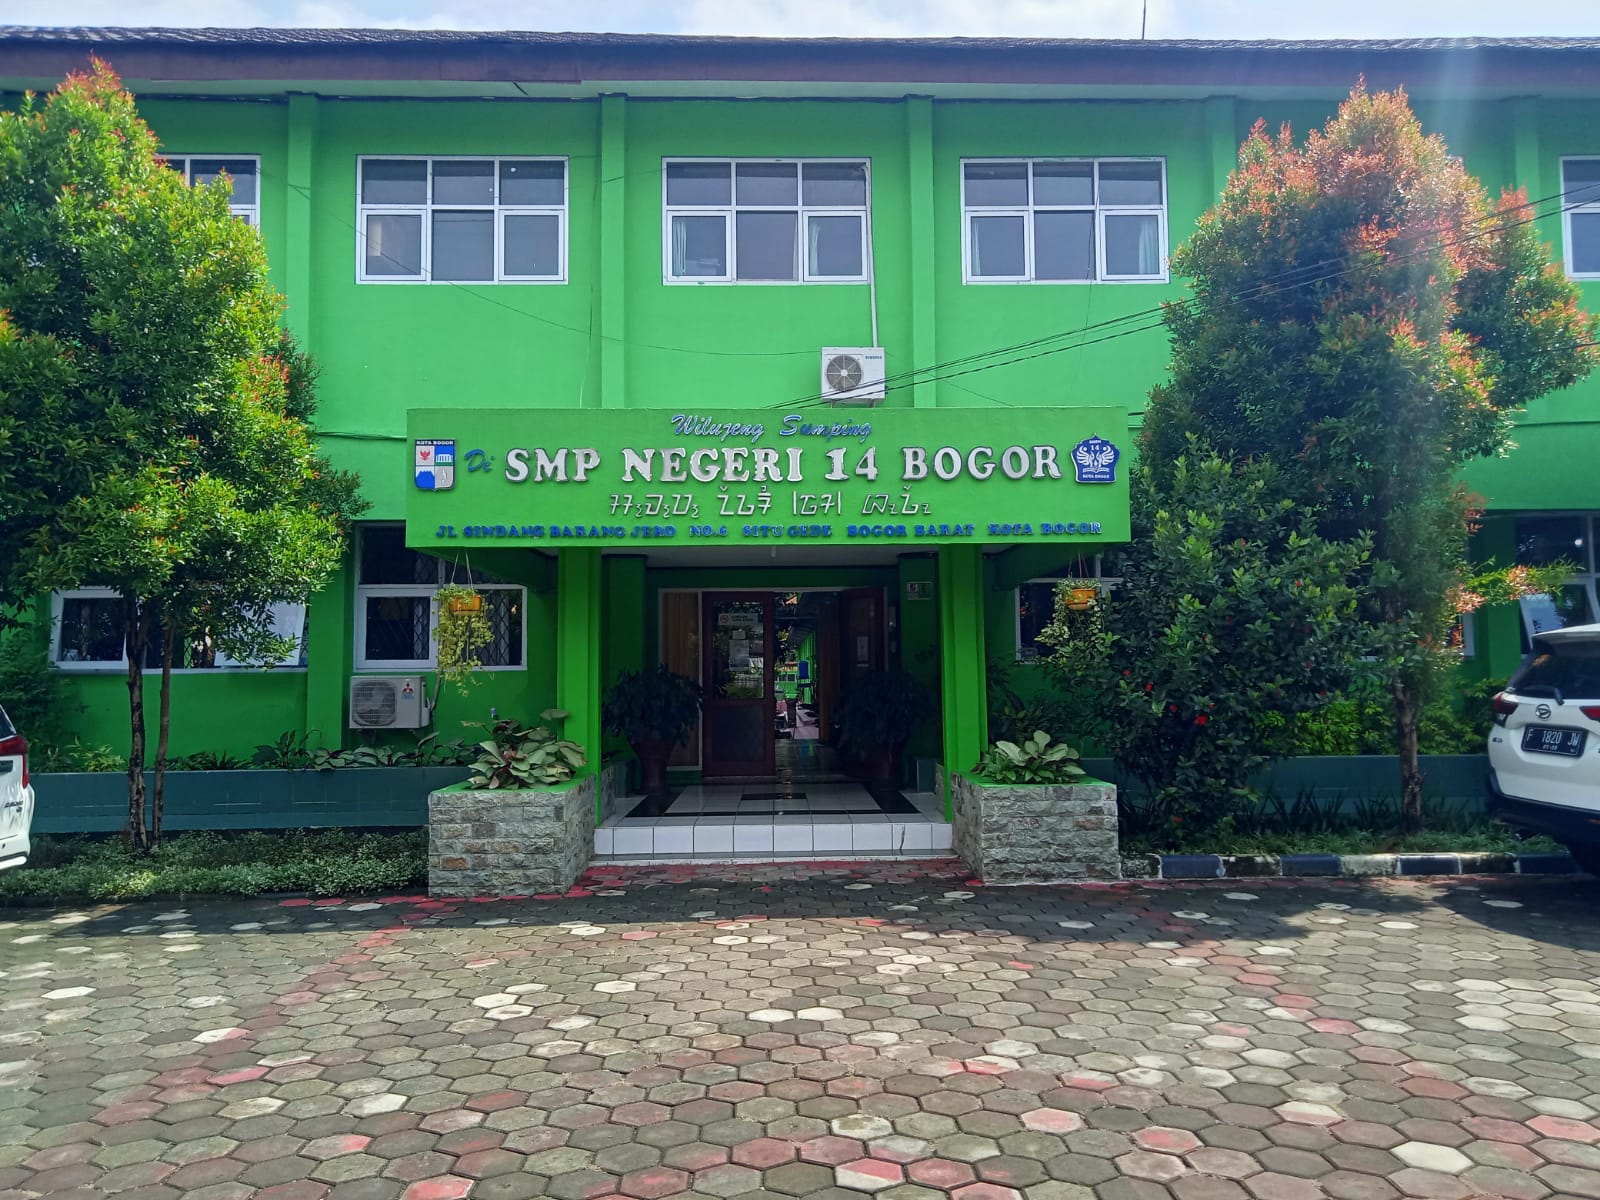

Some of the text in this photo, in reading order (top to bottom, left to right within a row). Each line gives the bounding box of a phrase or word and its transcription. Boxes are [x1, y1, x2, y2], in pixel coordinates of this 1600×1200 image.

[671, 414, 872, 443] Wilujeng Sumping
[505, 448, 601, 483] SMP
[621, 447, 804, 483] NEGERI
[825, 446, 879, 481] 14
[901, 445, 1063, 481] BOGOR
[436, 521, 1103, 538] JL SINDANG BARANG JERO NO.6 SITU GEDE BOGOR BARAT KOTA BOGOR
[1526, 728, 1535, 742] F
[1542, 730, 1563, 745] 1820
